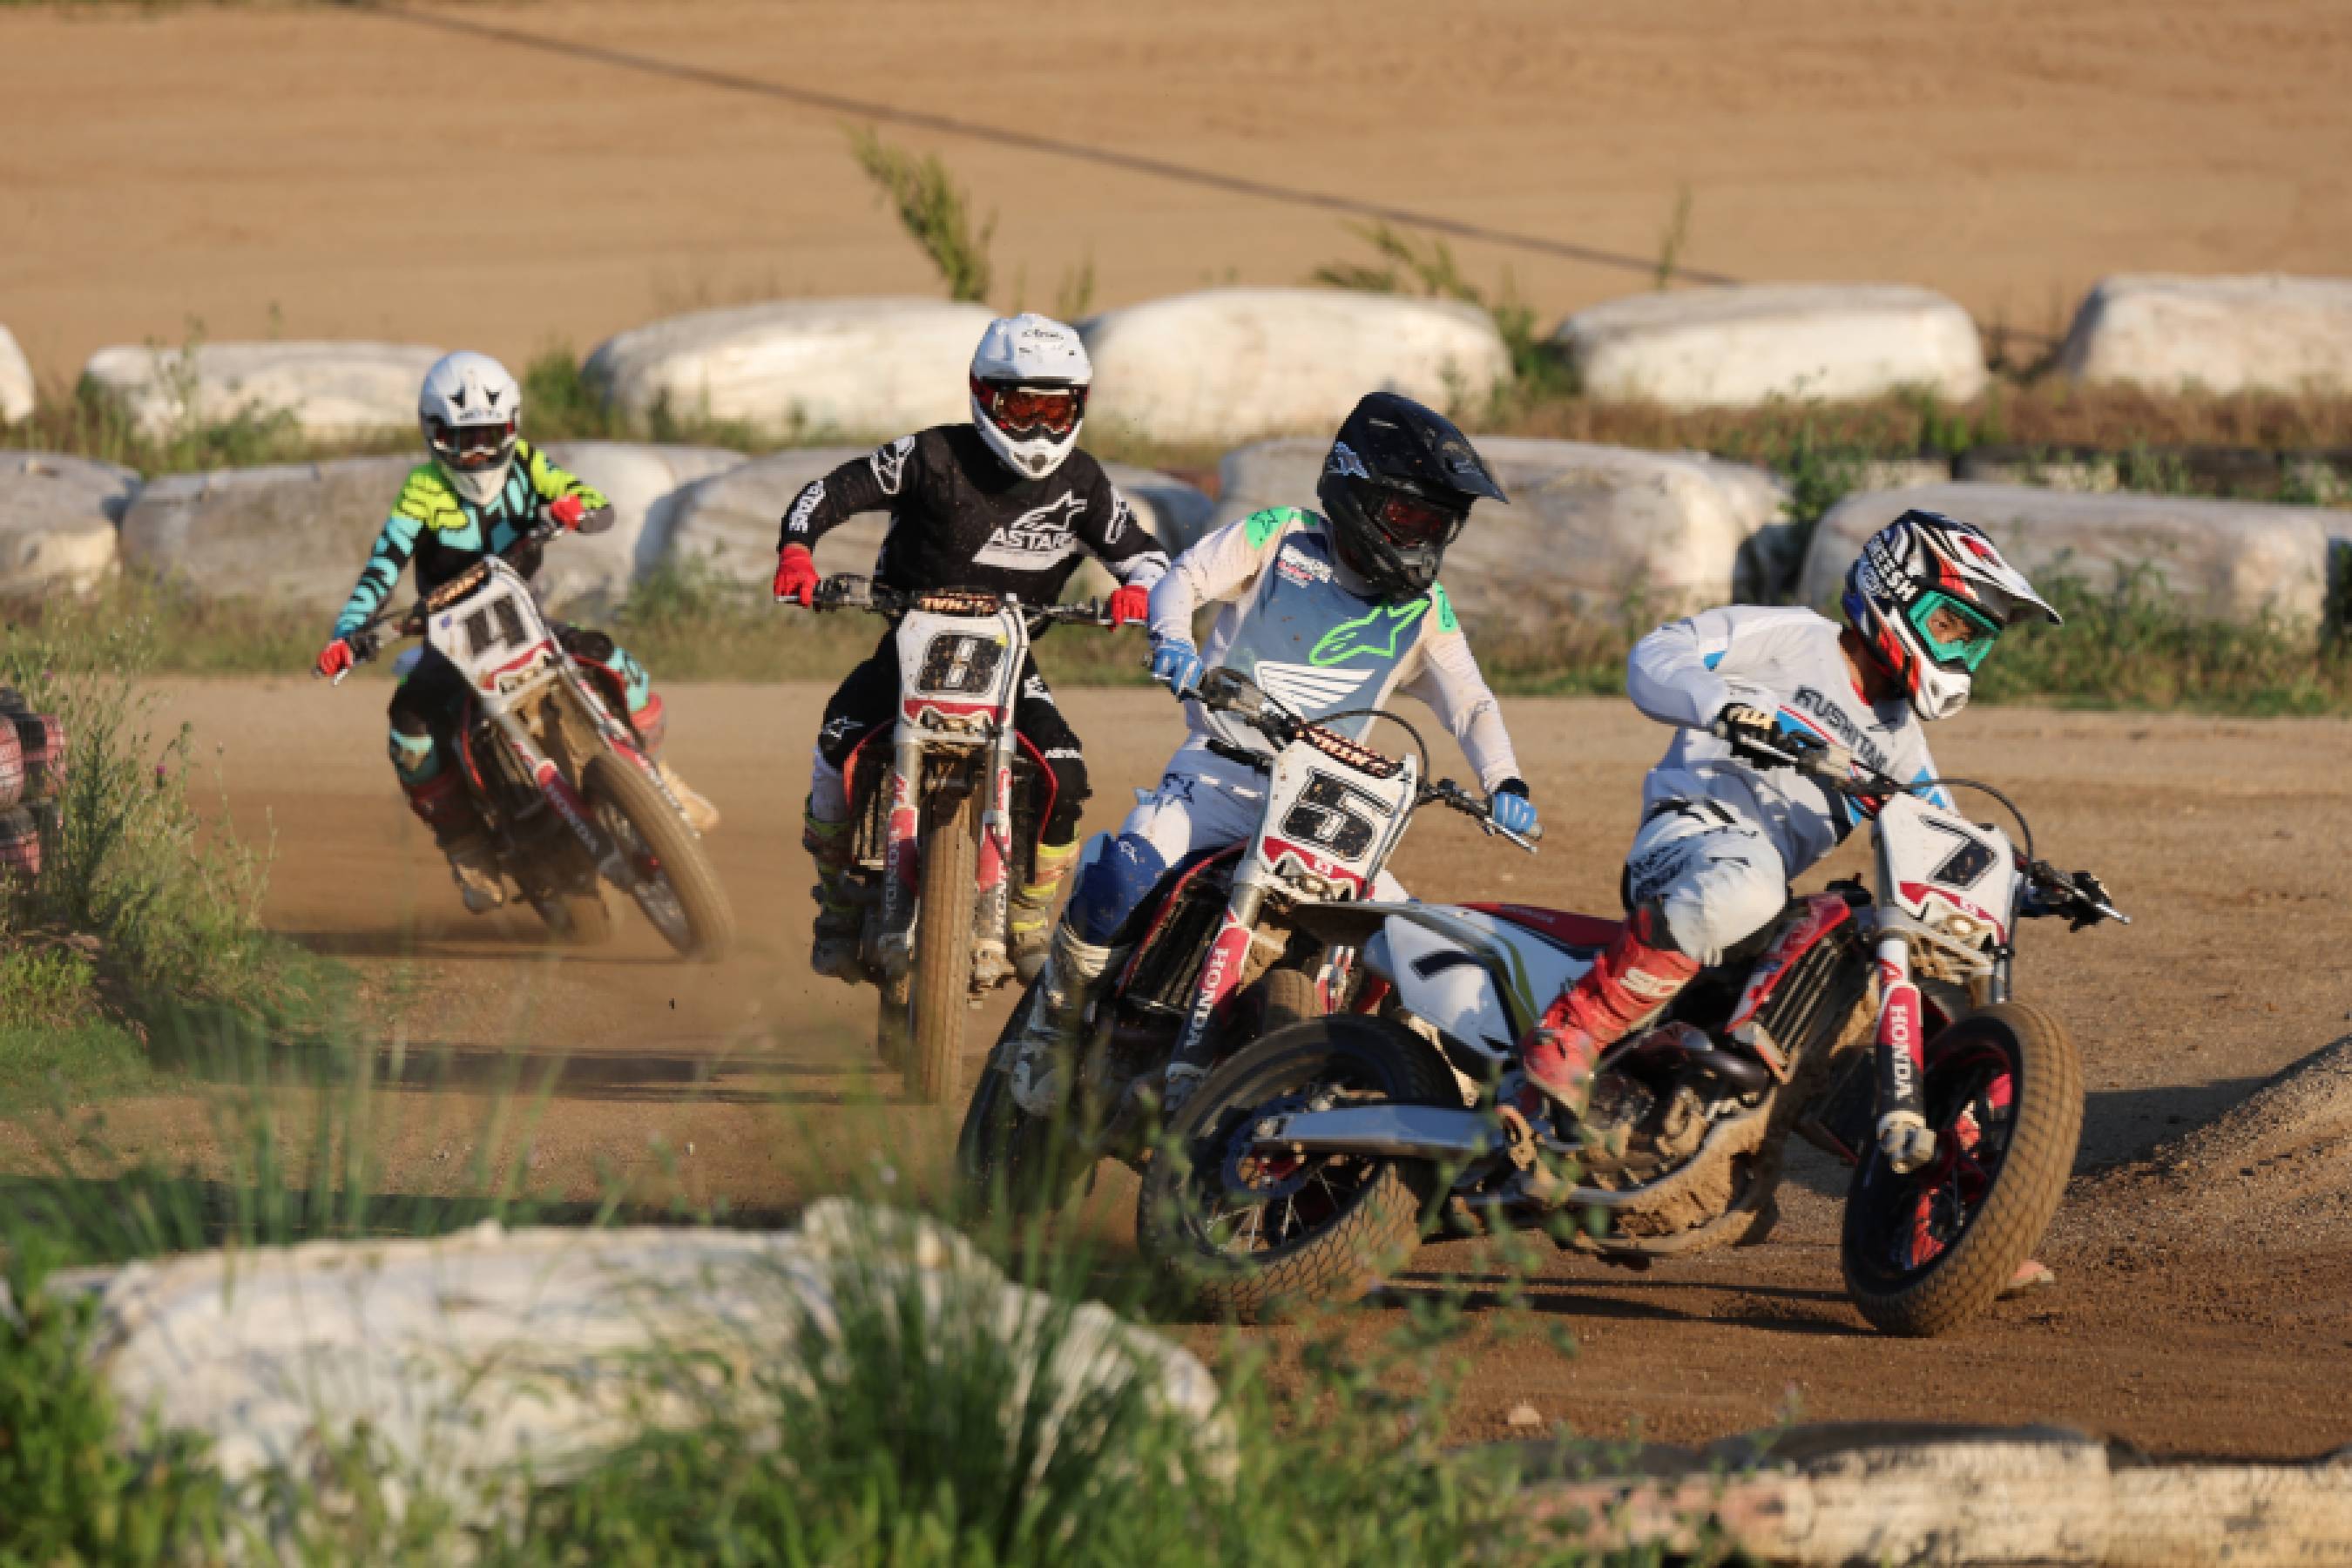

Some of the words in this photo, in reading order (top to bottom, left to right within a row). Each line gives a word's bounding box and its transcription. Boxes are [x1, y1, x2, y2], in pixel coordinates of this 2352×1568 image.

[918, 631, 1004, 693] 8
[1279, 767, 1393, 862] 5
[1919, 814, 1998, 891] 7
[1184, 948, 1229, 1051] HONDA
[1889, 1005, 1915, 1101] HONDA
